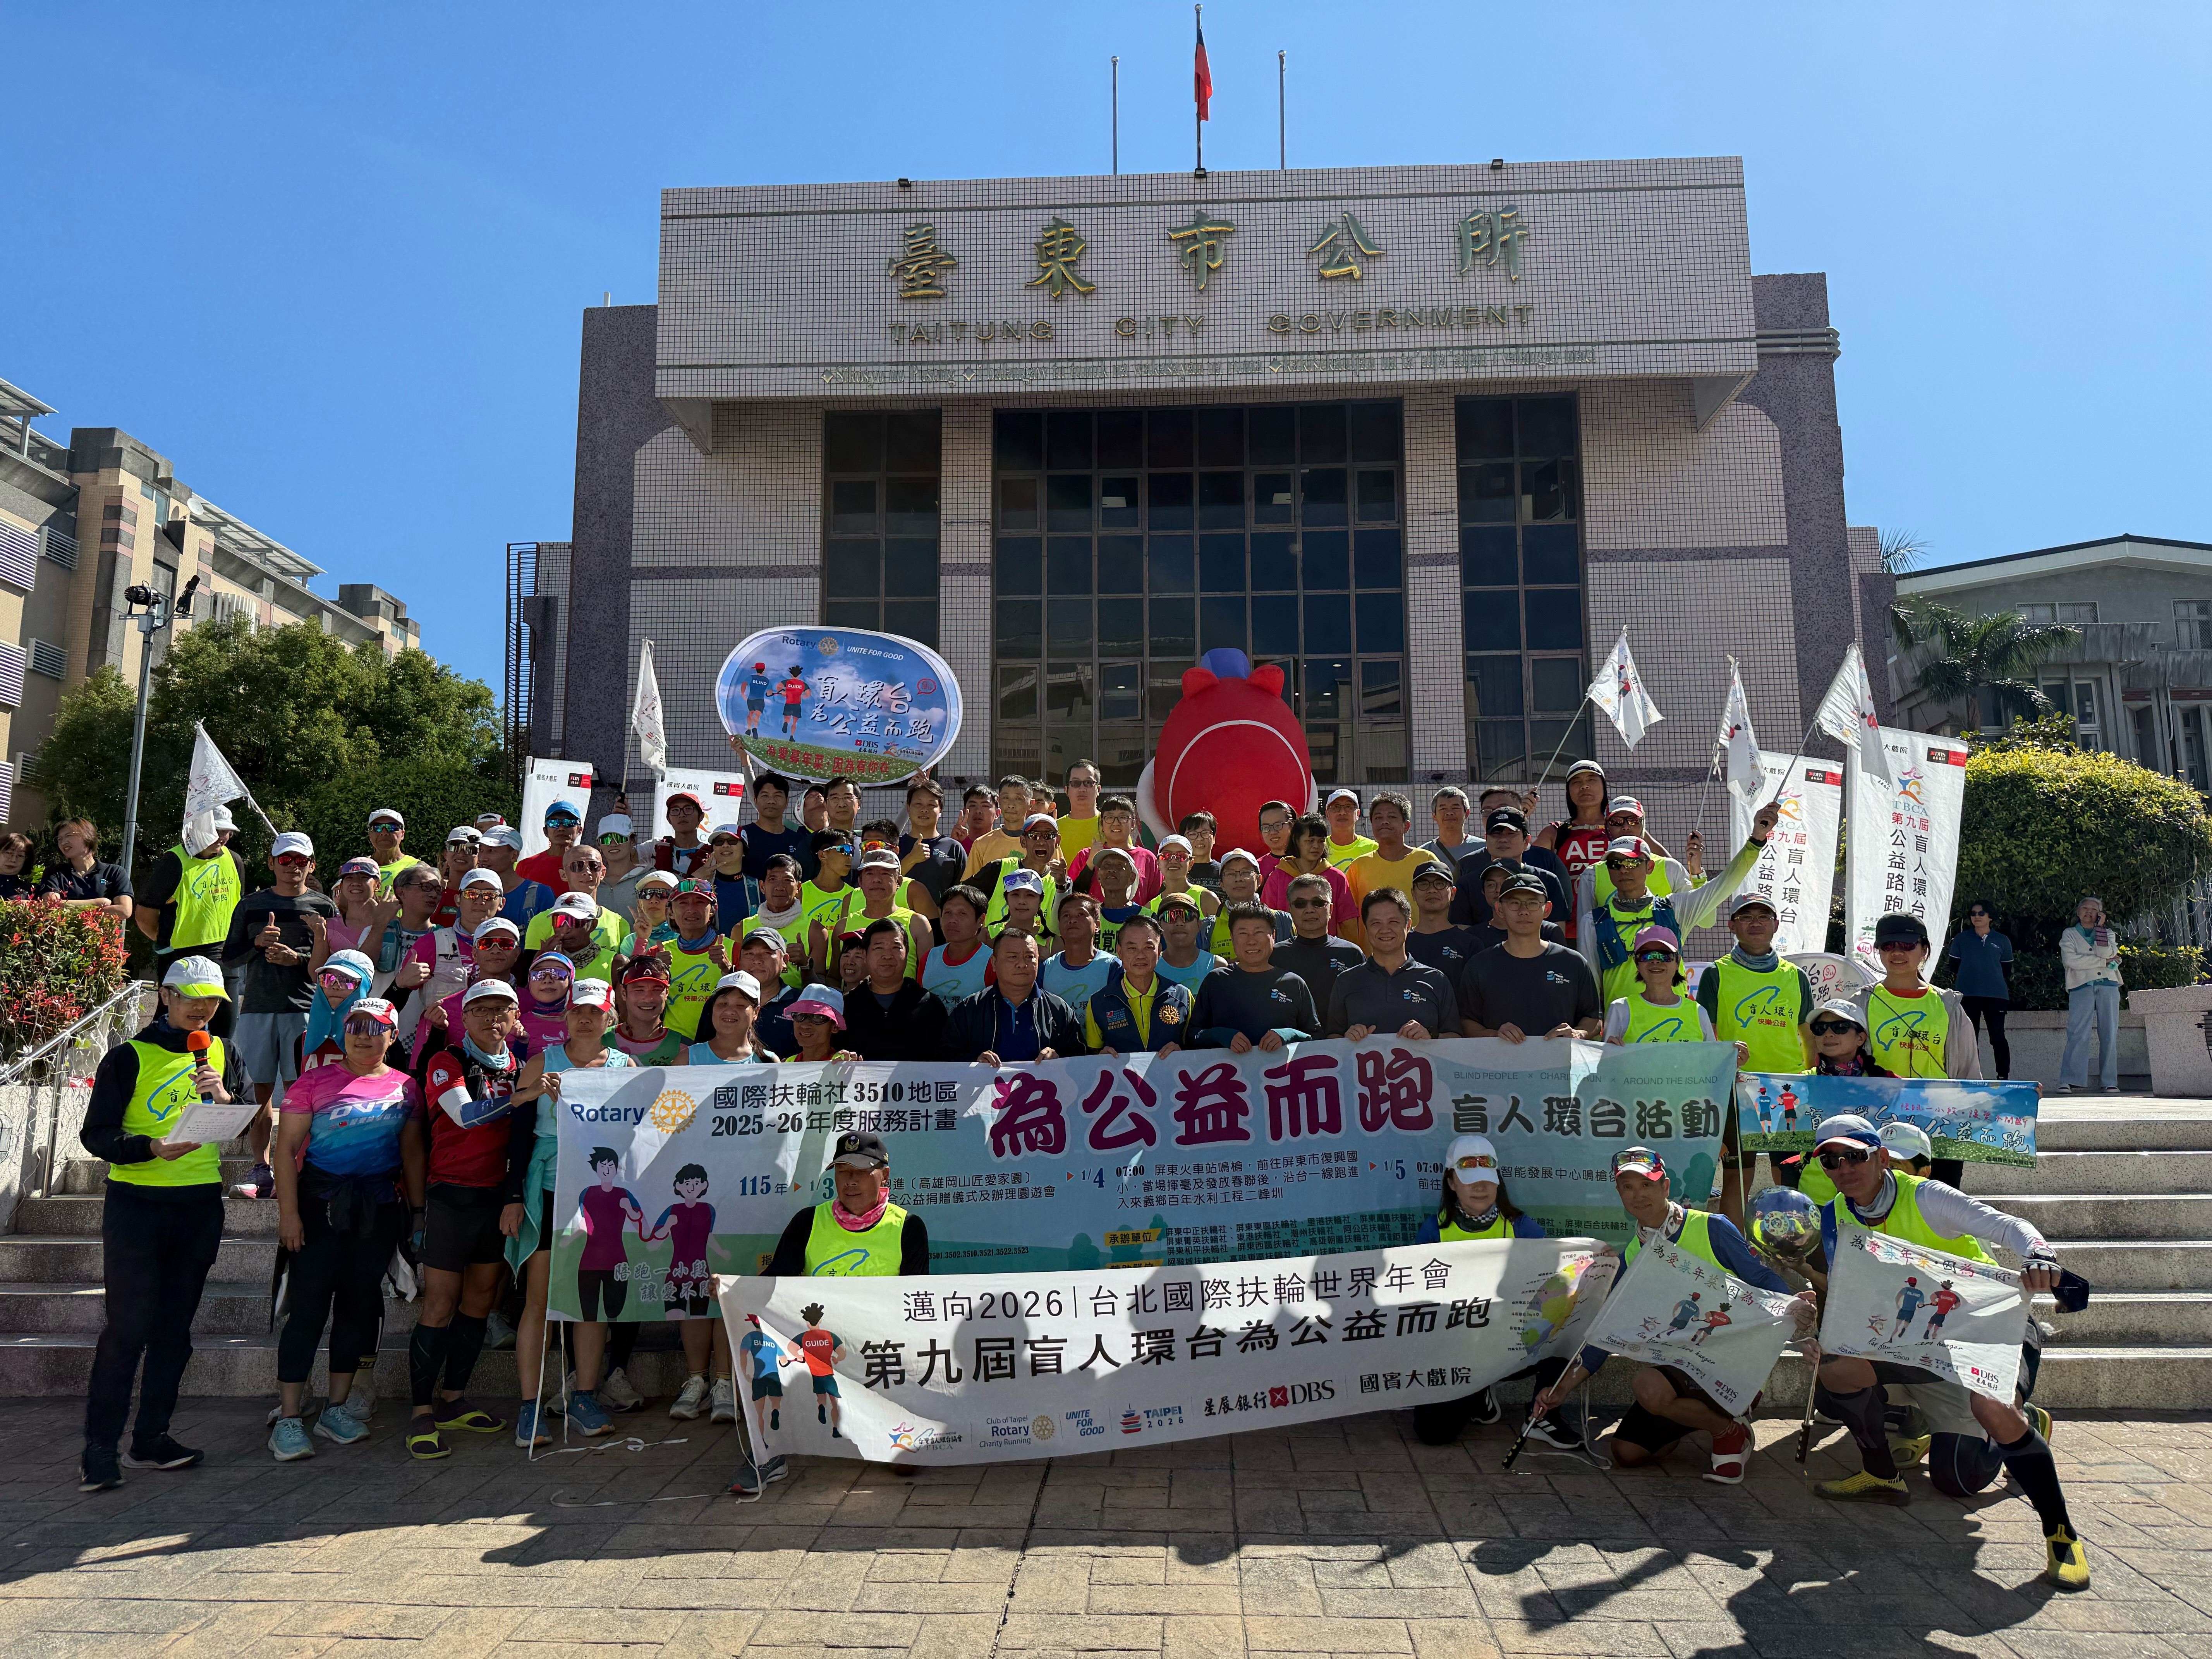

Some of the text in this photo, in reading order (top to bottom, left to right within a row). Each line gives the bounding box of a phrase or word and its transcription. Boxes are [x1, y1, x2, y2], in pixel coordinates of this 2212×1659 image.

[887, 204, 1529, 299] 臺東市公所
[888, 305, 1534, 342] TAITUNG CITY GOVERNMENT
[782, 635, 904, 661] Rotary UNITE FOR GOOD
[817, 674, 912, 714] 盲人環台
[810, 702, 934, 744] 為公益而跑
[862, 740, 879, 749] DBS
[1892, 799, 1929, 816] TBCA
[1773, 819, 1807, 831] BCA
[1891, 811, 1929, 833] 第九屆
[1765, 830, 1807, 845] 第九屆
[1566, 840, 1611, 860] AE
[1883, 829, 1906, 913] 公益路跑
[1911, 834, 1929, 919] 盲人環台
[1780, 848, 1806, 924] 盲人環台
[1602, 942, 1614, 964] NATHAN
[676, 982, 718, 993] 盲人環
[1747, 1003, 1793, 1020] 盲人環台
[1757, 1018, 1787, 1028] 快樂公益
[1454, 1072, 1718, 1085] BLIND PEOPLE CHARITY RUN AROUND THE ISLAND
[714, 1080, 958, 1109] 國際扶輪社3510地區
[989, 1047, 1433, 1158] 為公益而跑
[570, 1103, 645, 1125] Rotary
[1451, 1094, 1719, 1140] 盲人環台活動
[1081, 1167, 1105, 1188] 1/4
[1115, 1164, 1145, 1177] 07:00
[1383, 1159, 1443, 1180] 1/5 07:00
[739, 1175, 787, 1197] 115年
[810, 1178, 835, 1200] 1/3
[613, 1259, 709, 1282] 陪跑一小段
[903, 1290, 1063, 1322] 邁向2026
[1089, 1258, 1452, 1317] 台北國際扶輪世界年會
[753, 1339, 775, 1348] BLIND
[805, 1339, 830, 1348] GUIDE
[859, 1296, 1492, 1389] 第九屆盲人環台為公益而跑
[1360, 1366, 1471, 1394] 國賓大戲院
[1980, 1369, 1999, 1383] DBS
[1290, 1379, 1335, 1405] DBS
[1721, 1384, 1739, 1399] DBS
[1065, 1409, 1090, 1420] UNITE
[1143, 1405, 1182, 1419] TAIPEI
[1204, 1392, 1268, 1417] 星展銀行
[1009, 1415, 1028, 1424] Taipei
[1076, 1418, 1093, 1428] FOR
[1147, 1416, 1183, 1428] 2026
[991, 1425, 1029, 1437] Rotary
[1080, 1426, 1104, 1436] GOOD
[979, 1439, 1002, 1448] Charity
